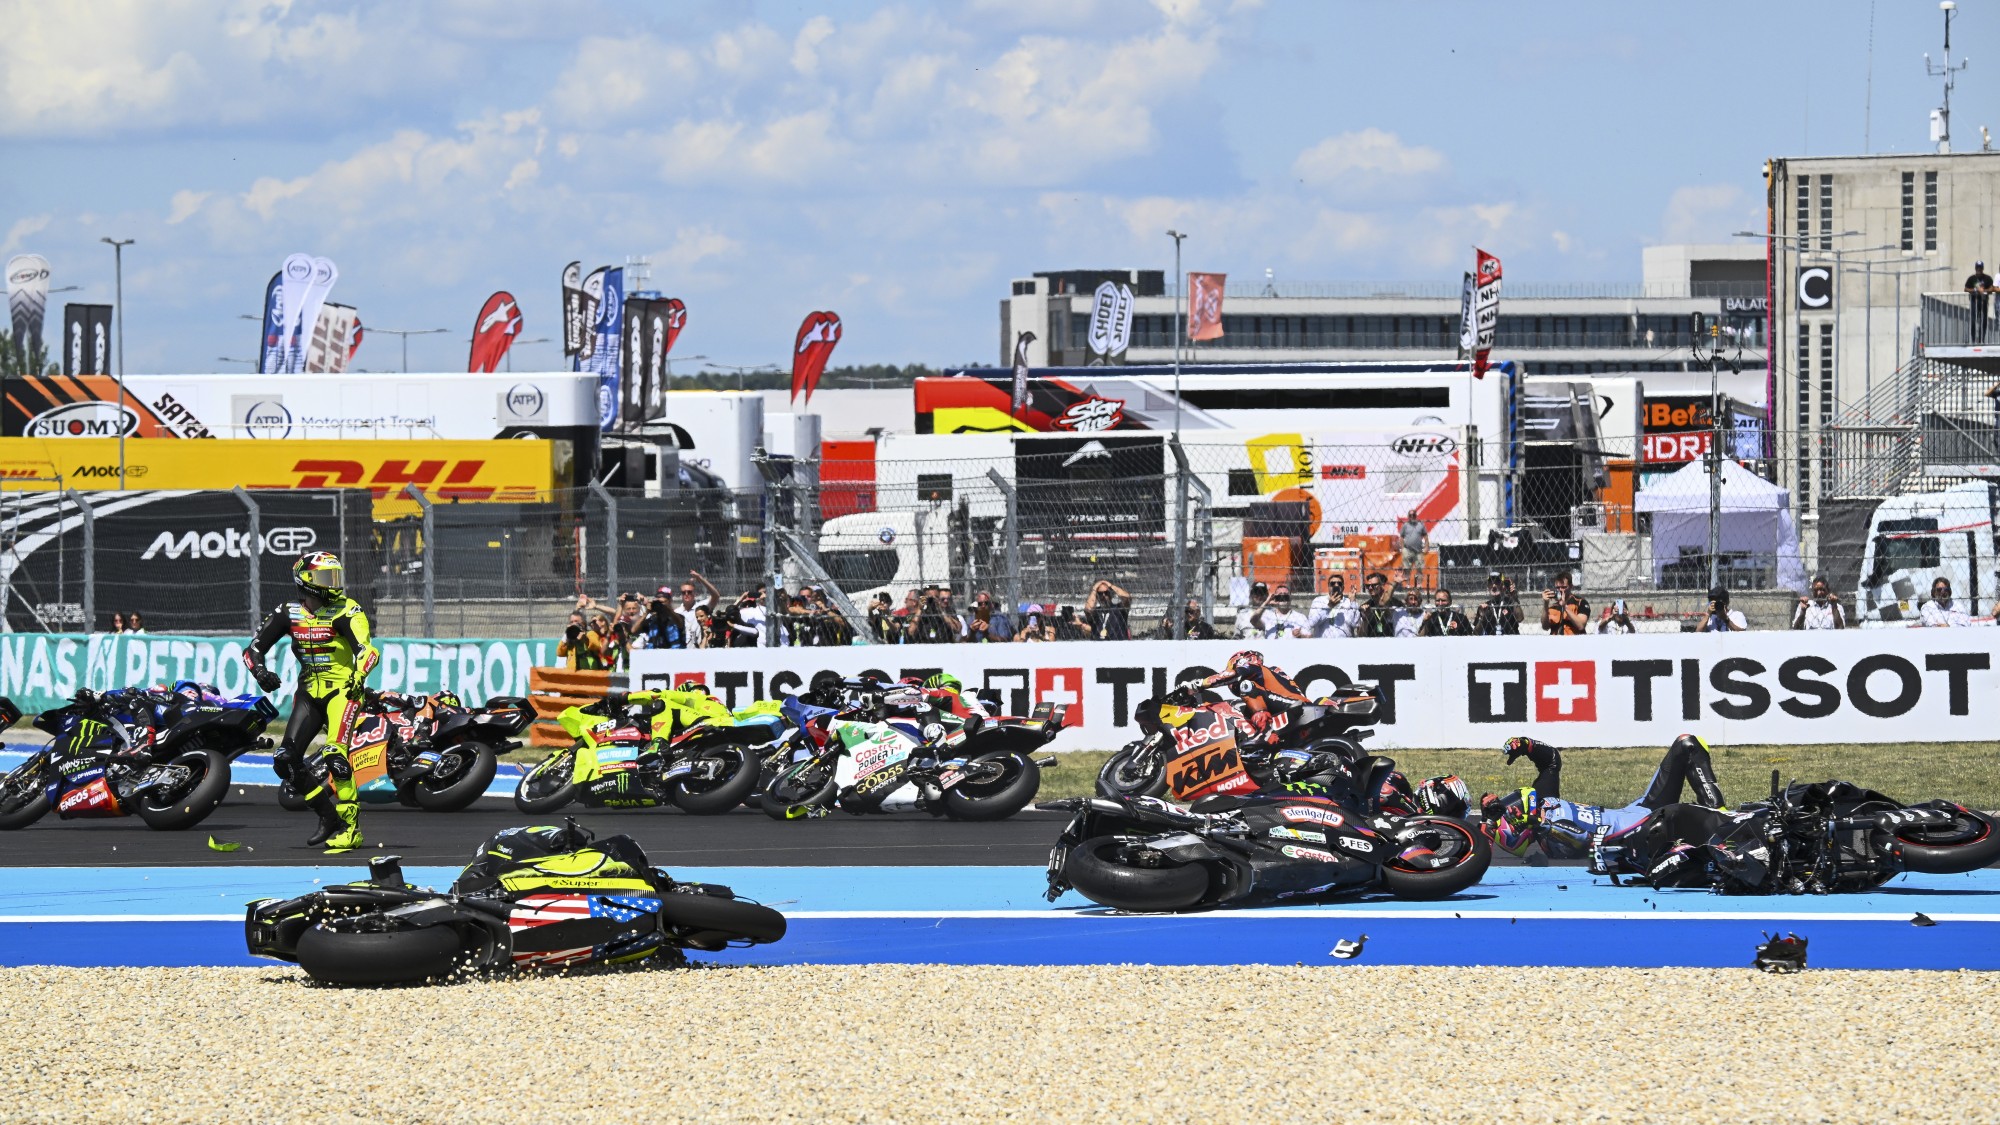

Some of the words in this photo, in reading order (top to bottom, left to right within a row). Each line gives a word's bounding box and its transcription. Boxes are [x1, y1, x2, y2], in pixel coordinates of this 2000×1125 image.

[1801, 268, 1829, 306] C
[512, 394, 536, 405] ATPI
[38, 419, 126, 436] SUOMY
[302, 415, 385, 431] Motorsport
[390, 414, 436, 428] Travel
[1397, 437, 1450, 453] NHK
[72, 465, 148, 478] MotoGP
[291, 460, 496, 500] DHL
[140, 526, 317, 560] MotoGP
[1612, 653, 1990, 721] TISSOT
[350, 717, 388, 750] ed
[1171, 712, 1230, 754] Red
[353, 752, 370, 764] inter
[1173, 747, 1238, 794] KTM
[1217, 774, 1249, 792] MOTUL
[60, 788, 89, 811] ENEOS
[88, 790, 109, 806] YAMAHA
[1286, 808, 1339, 823] sterilgarda
[1350, 839, 1370, 850] FES
